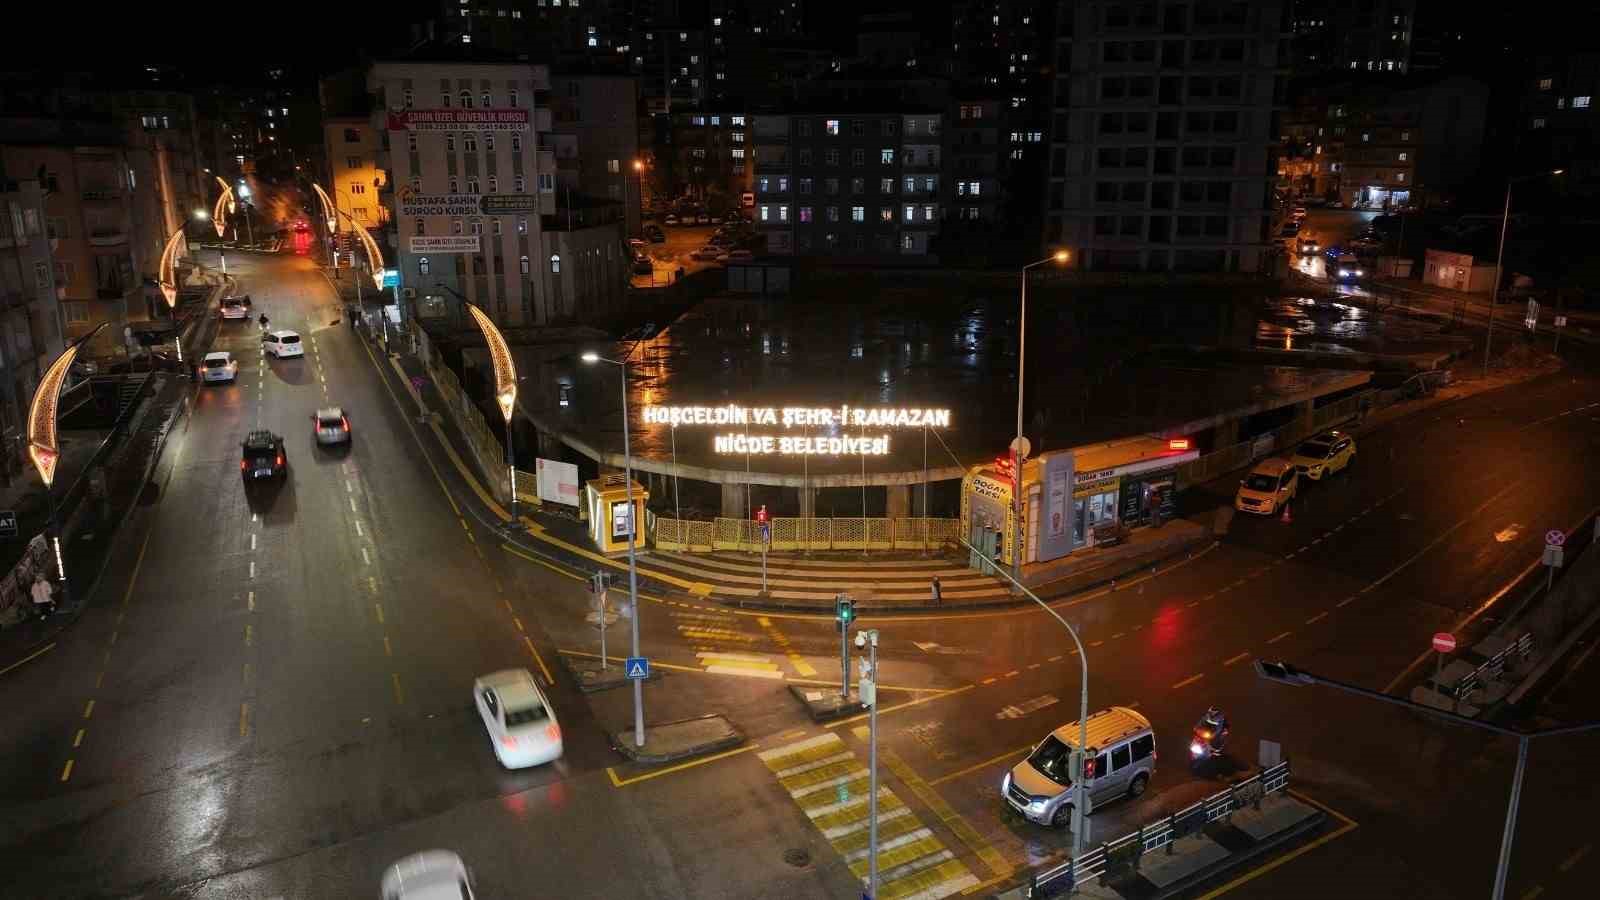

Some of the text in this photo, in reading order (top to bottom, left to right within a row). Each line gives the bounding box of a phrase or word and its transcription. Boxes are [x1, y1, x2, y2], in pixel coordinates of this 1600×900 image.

[753, 408, 777, 425] YA
[853, 408, 950, 427] RAMAZAN
[779, 434, 890, 454] BELEDİYESİ
